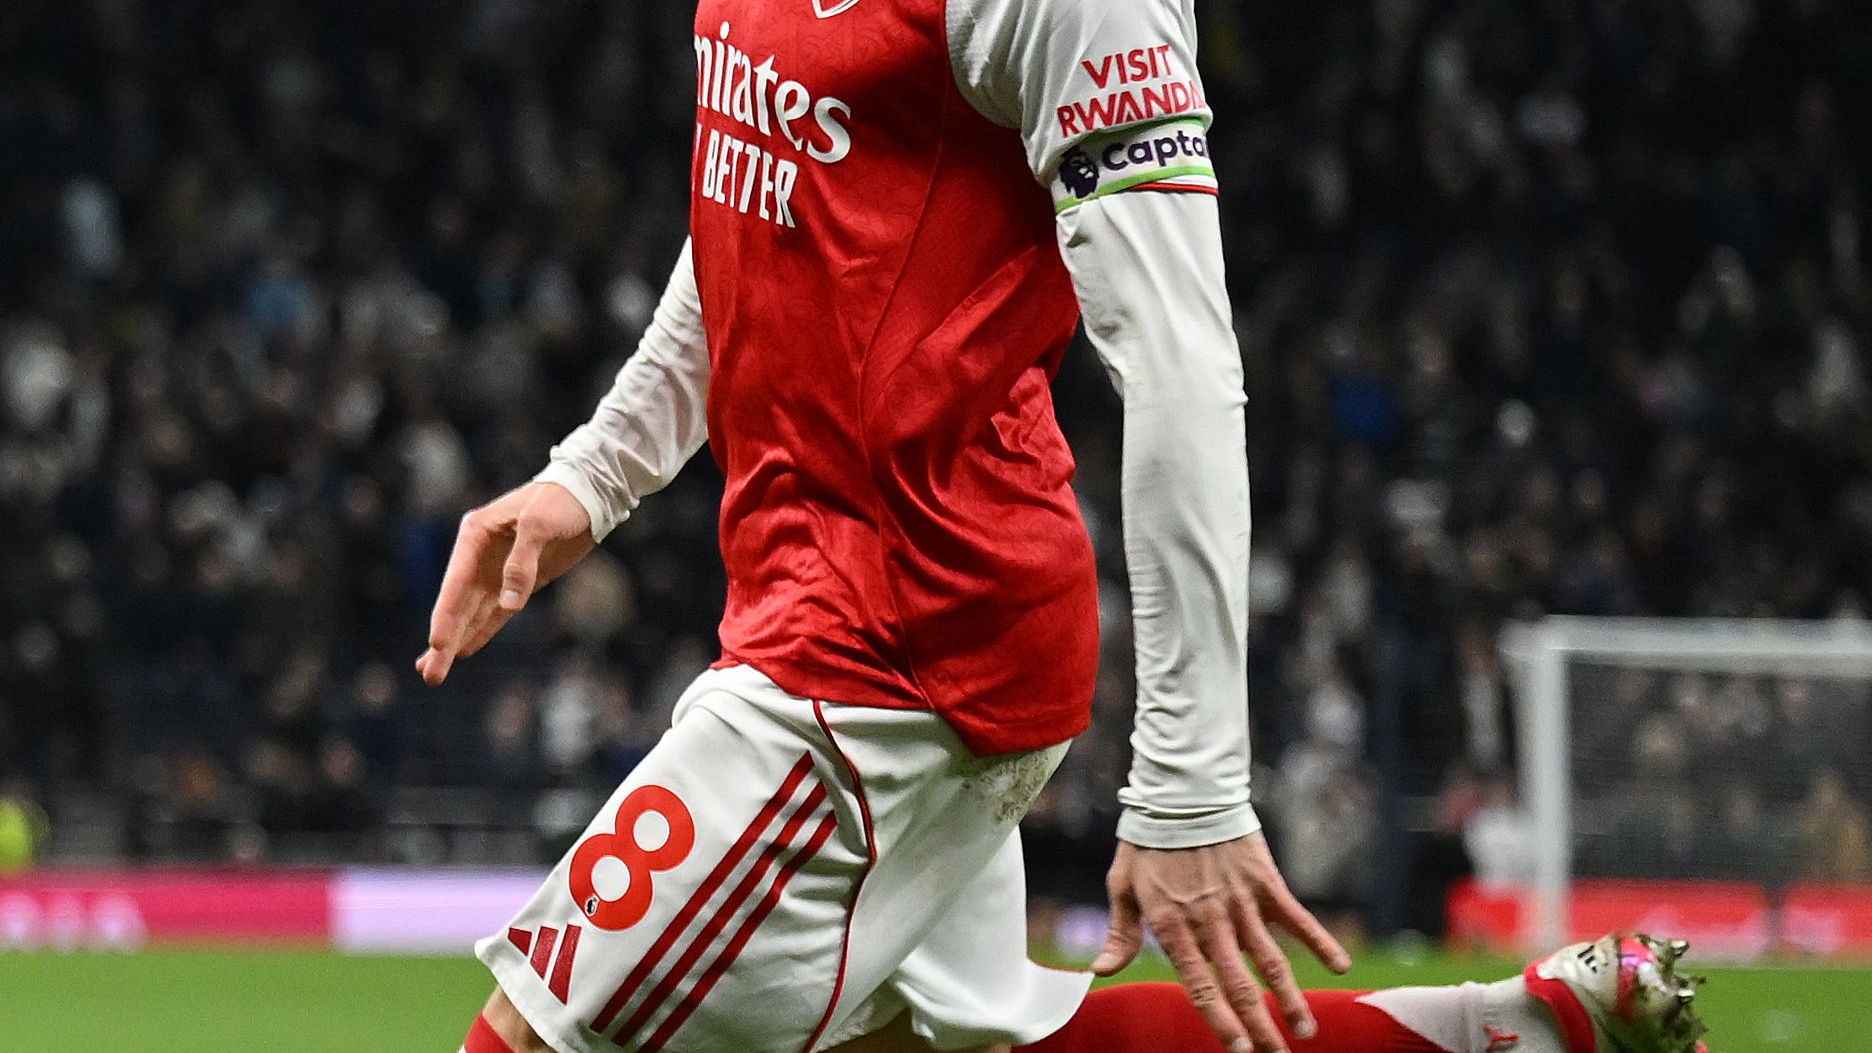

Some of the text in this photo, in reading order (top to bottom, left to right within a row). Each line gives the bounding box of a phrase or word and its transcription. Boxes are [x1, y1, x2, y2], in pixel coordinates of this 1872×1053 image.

[694, 21, 851, 164] mirates
[1081, 44, 1172, 89] VISIT
[702, 128, 798, 228] BETTER
[568, 784, 696, 932] 8
